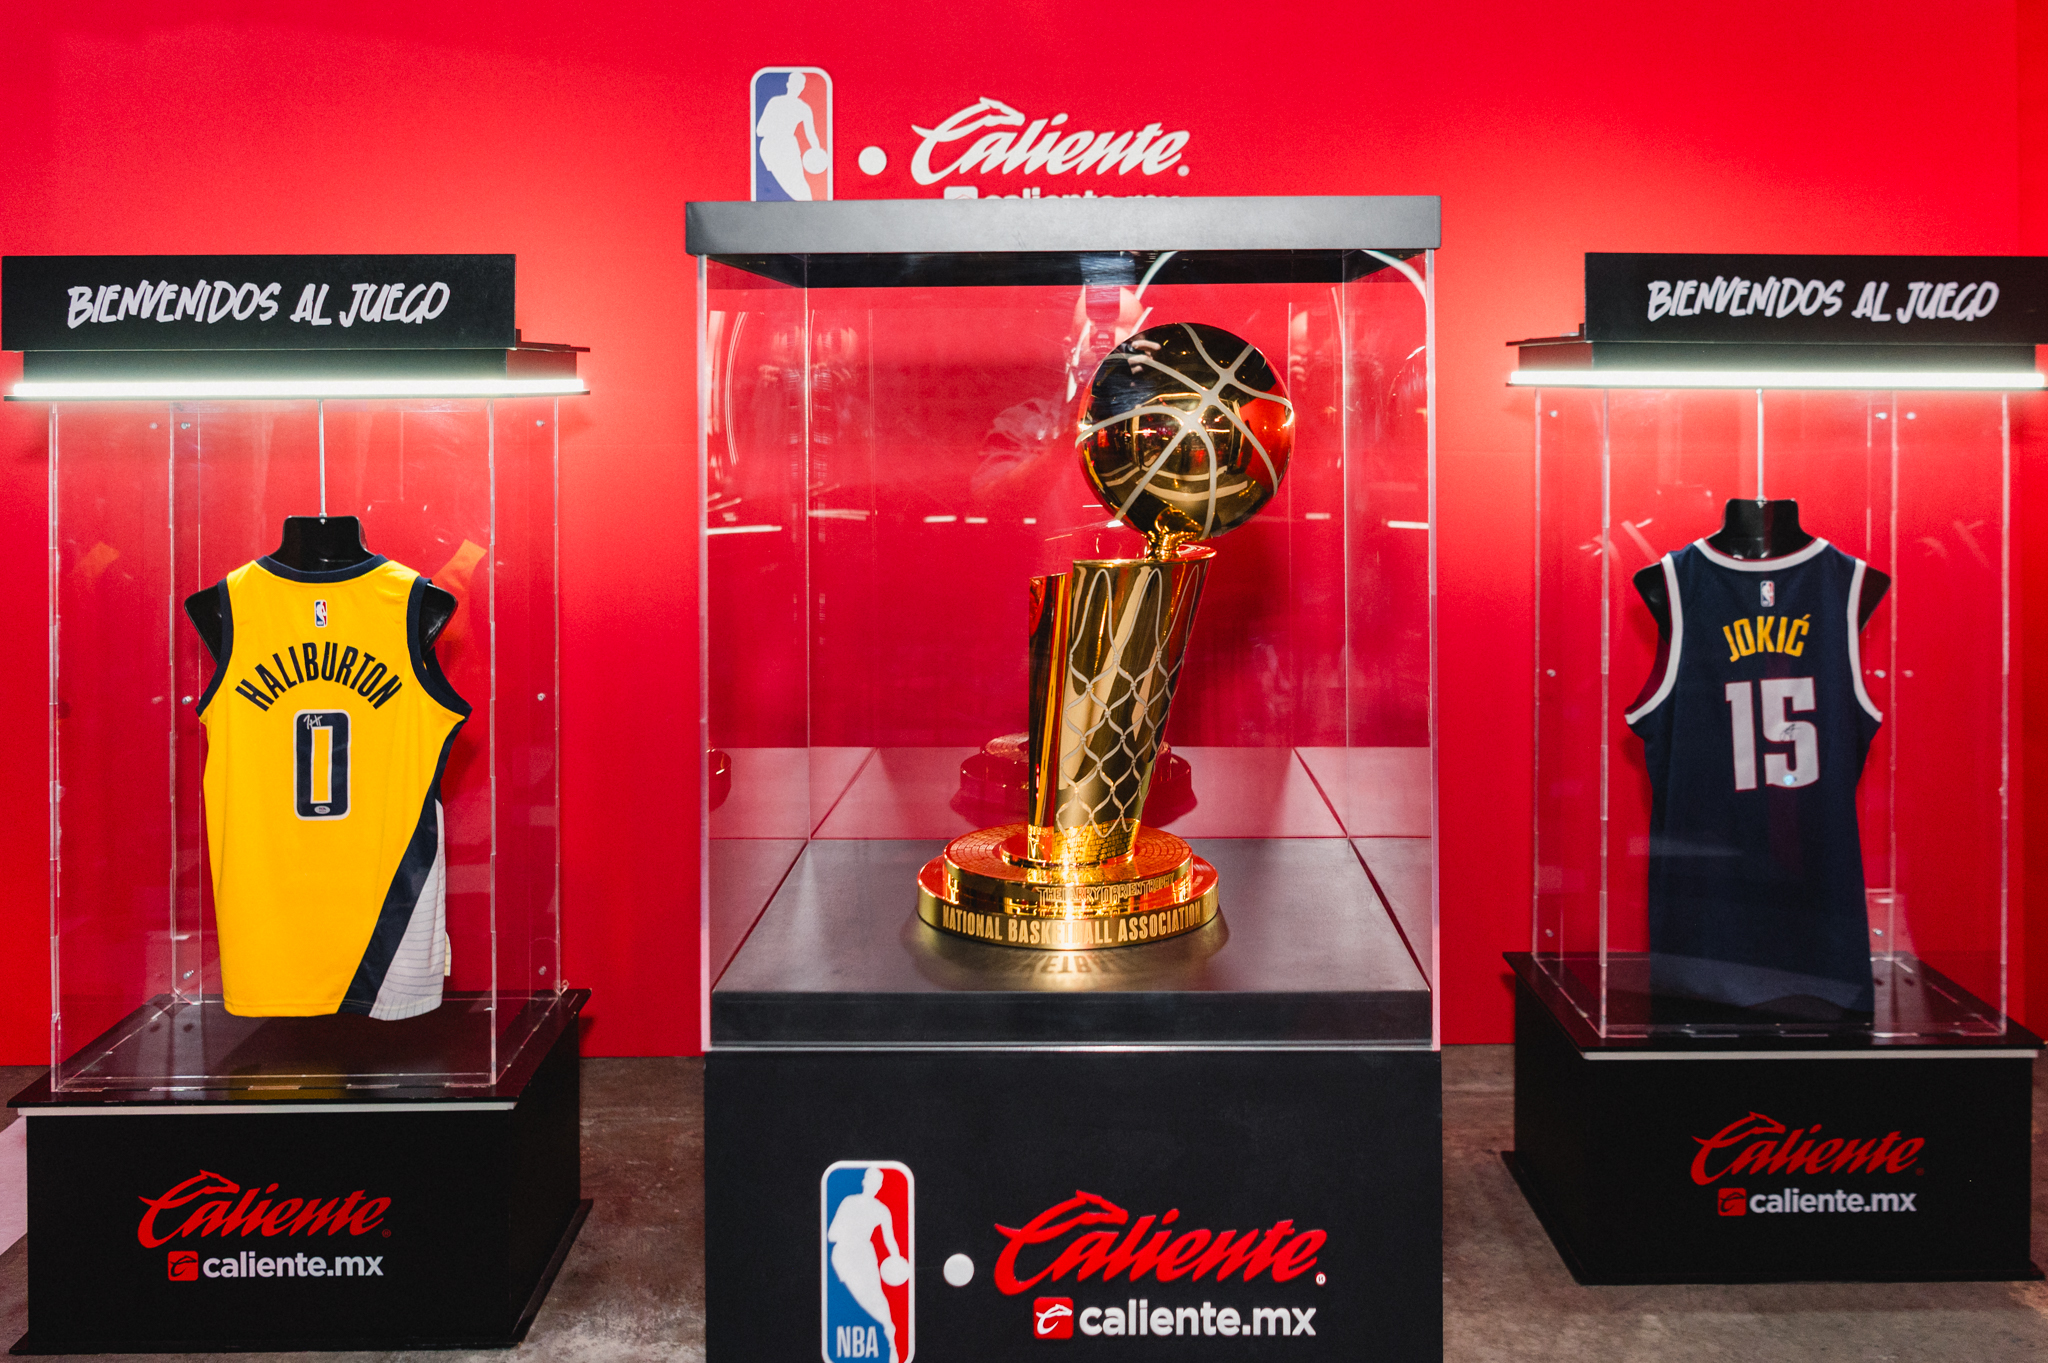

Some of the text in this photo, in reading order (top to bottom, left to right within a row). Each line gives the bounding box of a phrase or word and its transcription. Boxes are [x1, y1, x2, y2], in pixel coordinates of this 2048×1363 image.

[910, 97, 1190, 186] Caliente
[67, 280, 451, 329] BIENVENIDOS AL JUEGO
[1647, 276, 2000, 324] BIENVENIDOS AL JUEGO
[1722, 614, 1811, 662] JOKIĆ
[234, 641, 403, 712] HALIBURTON
[1724, 677, 1820, 793] 15
[293, 709, 351, 821] 0
[943, 904, 1002, 941] NATIONAL
[1008, 917, 1112, 945] BASKETBALL
[1117, 901, 1201, 943] ASSOCIATION
[1690, 1111, 1925, 1186] Caliente
[137, 1169, 392, 1249] Caliente
[1749, 1187, 1917, 1214] caliente.mx
[202, 1251, 384, 1278] caliente.mx
[993, 1189, 1328, 1296] Caliente
[1079, 1298, 1317, 1336] caliente.mx
[836, 1325, 880, 1359] NBA
